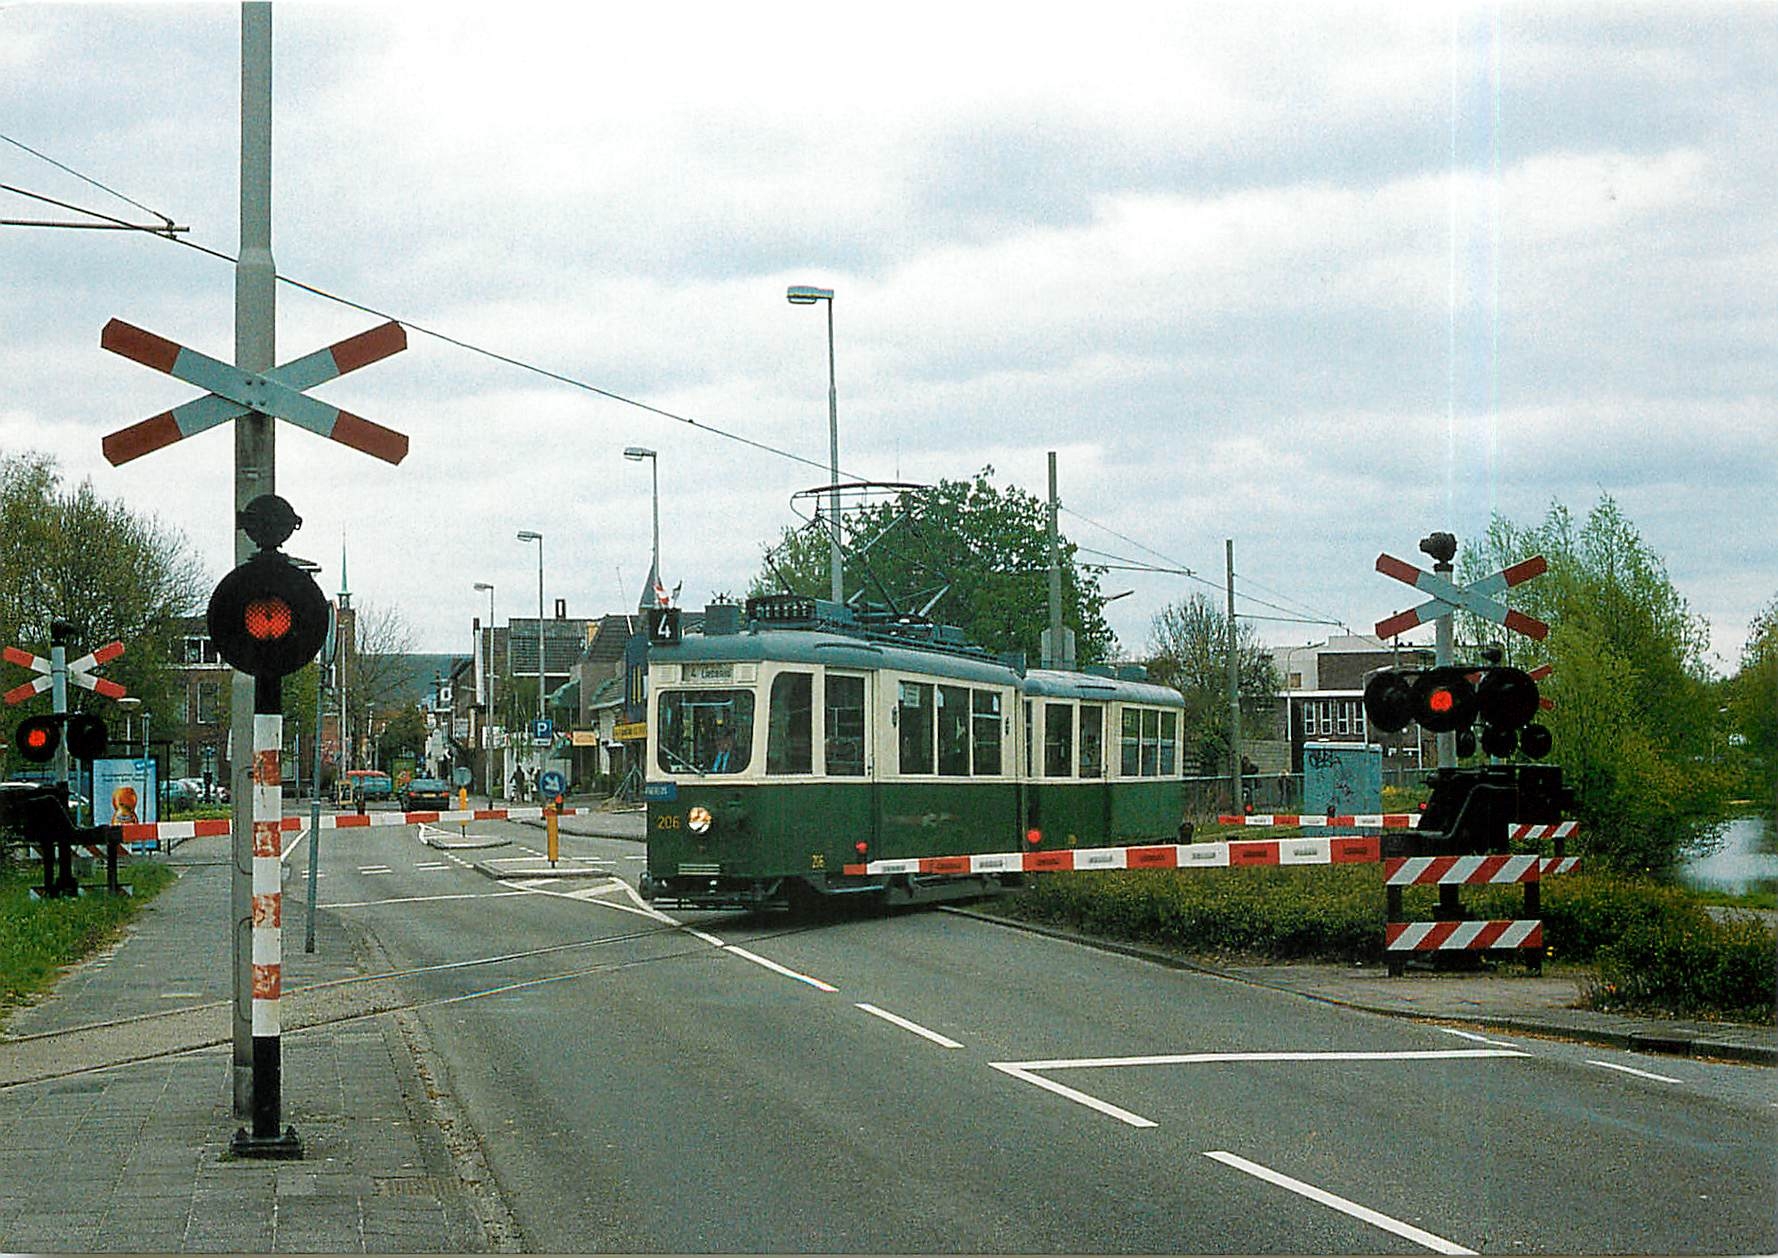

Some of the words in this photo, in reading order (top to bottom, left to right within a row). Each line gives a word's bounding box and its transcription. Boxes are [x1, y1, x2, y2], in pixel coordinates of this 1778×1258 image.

[657, 613, 672, 638] 4
[537, 722, 548, 737] P
[657, 816, 681, 830] 206
